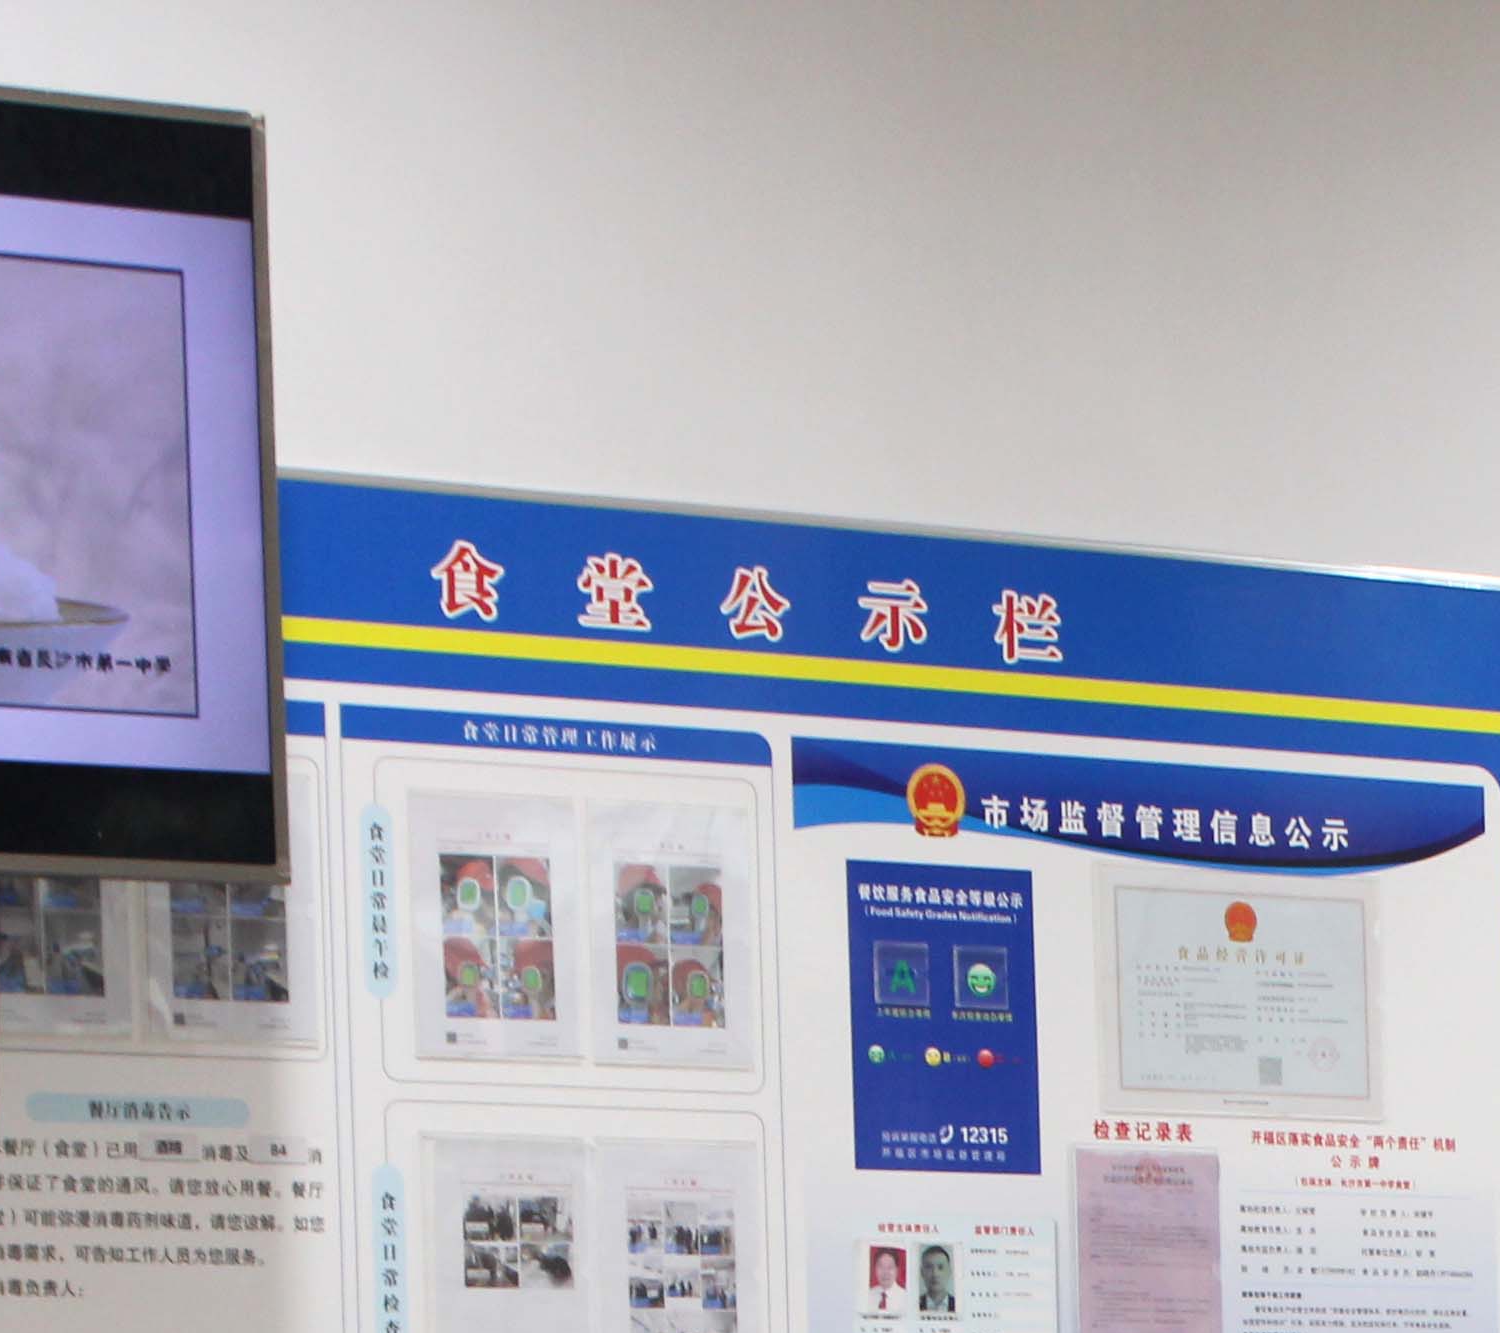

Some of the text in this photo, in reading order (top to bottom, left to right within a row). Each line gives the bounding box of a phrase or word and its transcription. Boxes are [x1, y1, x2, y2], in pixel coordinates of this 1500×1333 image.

[430, 540, 1064, 663] 食堂公示栏
[463, 720, 656, 752] 食堂日常管理工作展示
[980, 794, 1350, 852] 市场监督管理信息公示
[858, 883, 1023, 909] 餐饮服务食品安全等级公示
[894, 908, 924, 920] Safety
[925, 910, 957, 921] Grades
[1178, 946, 1304, 965] 食品经营许可证
[890, 960, 916, 994] A
[88, 1101, 191, 1121] 餐厅消毒告示
[960, 1126, 1008, 1144] 12315
[1094, 1120, 1193, 1142] 检查记录表
[1331, 1155, 1380, 1169] 公示牌
